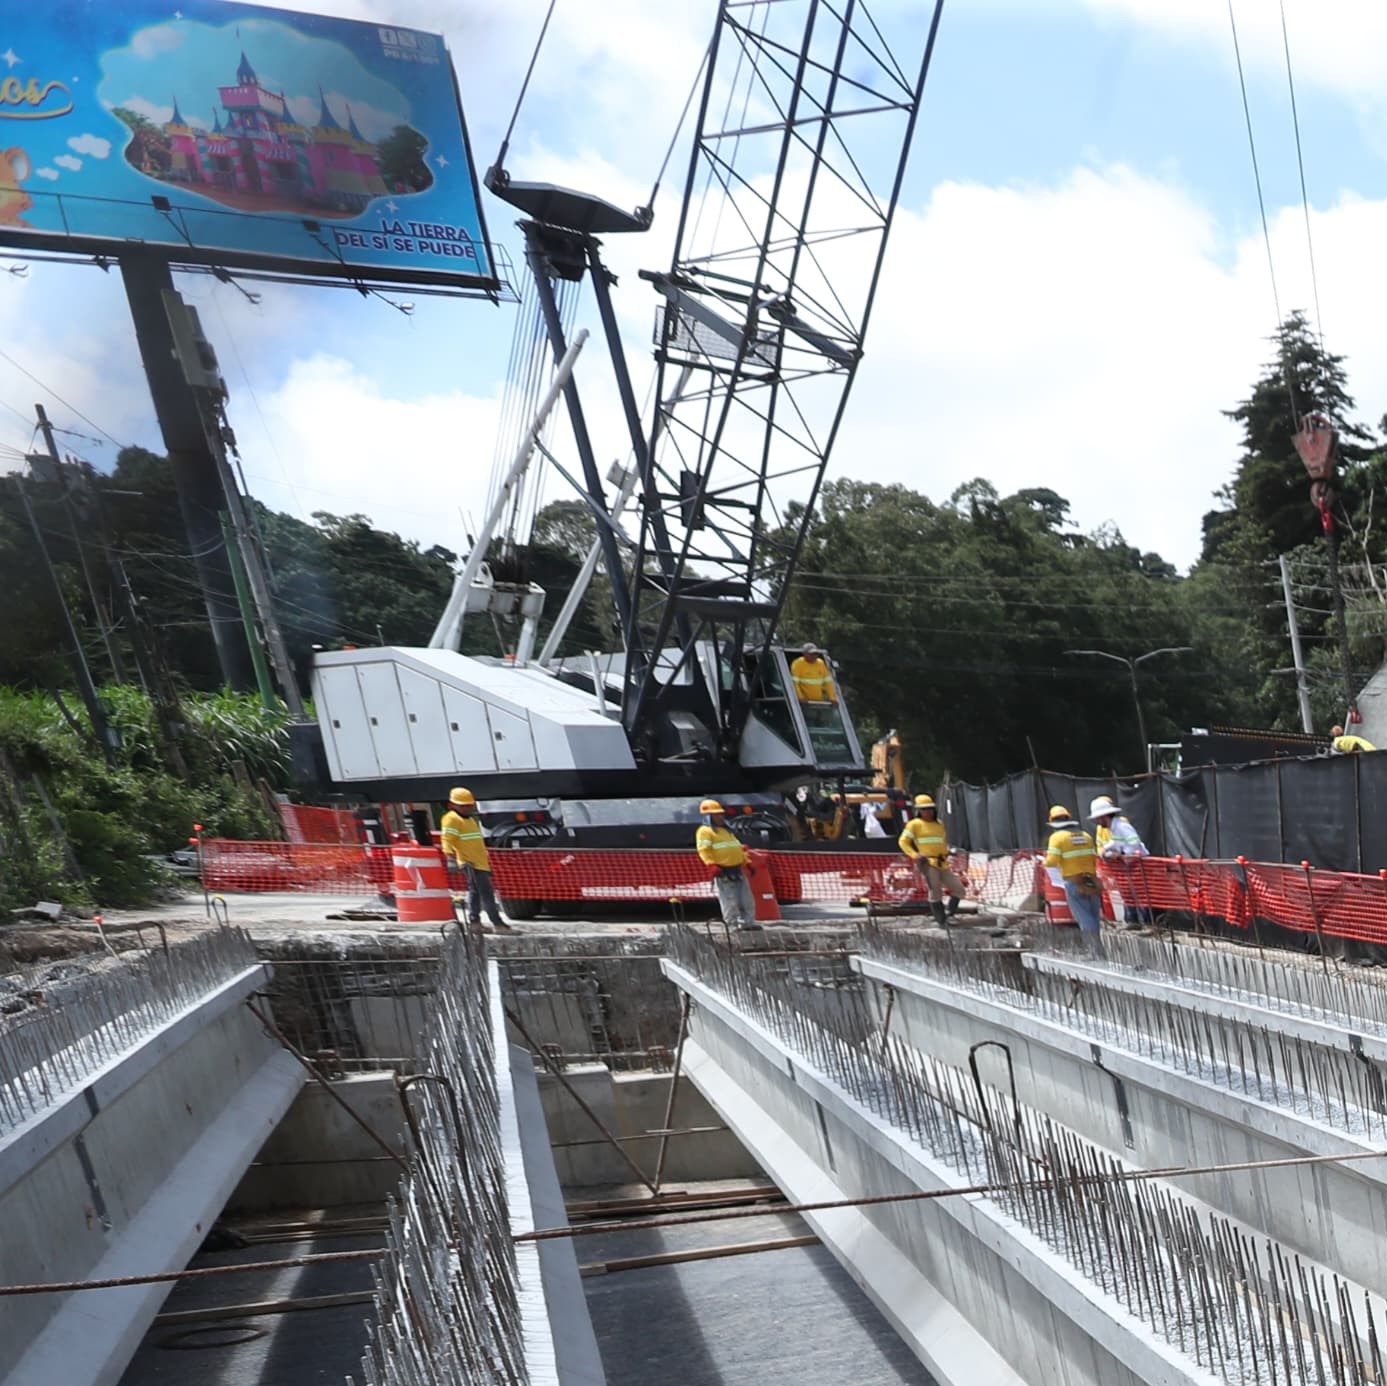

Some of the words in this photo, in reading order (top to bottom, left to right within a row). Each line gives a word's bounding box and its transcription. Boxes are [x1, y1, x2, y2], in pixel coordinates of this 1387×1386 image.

[382, 220, 406, 235] LA
[408, 222, 472, 242] TIERRA
[336, 232, 368, 248] DEL
[394, 238, 414, 252] SE
[418, 241, 475, 259] PUEDE
